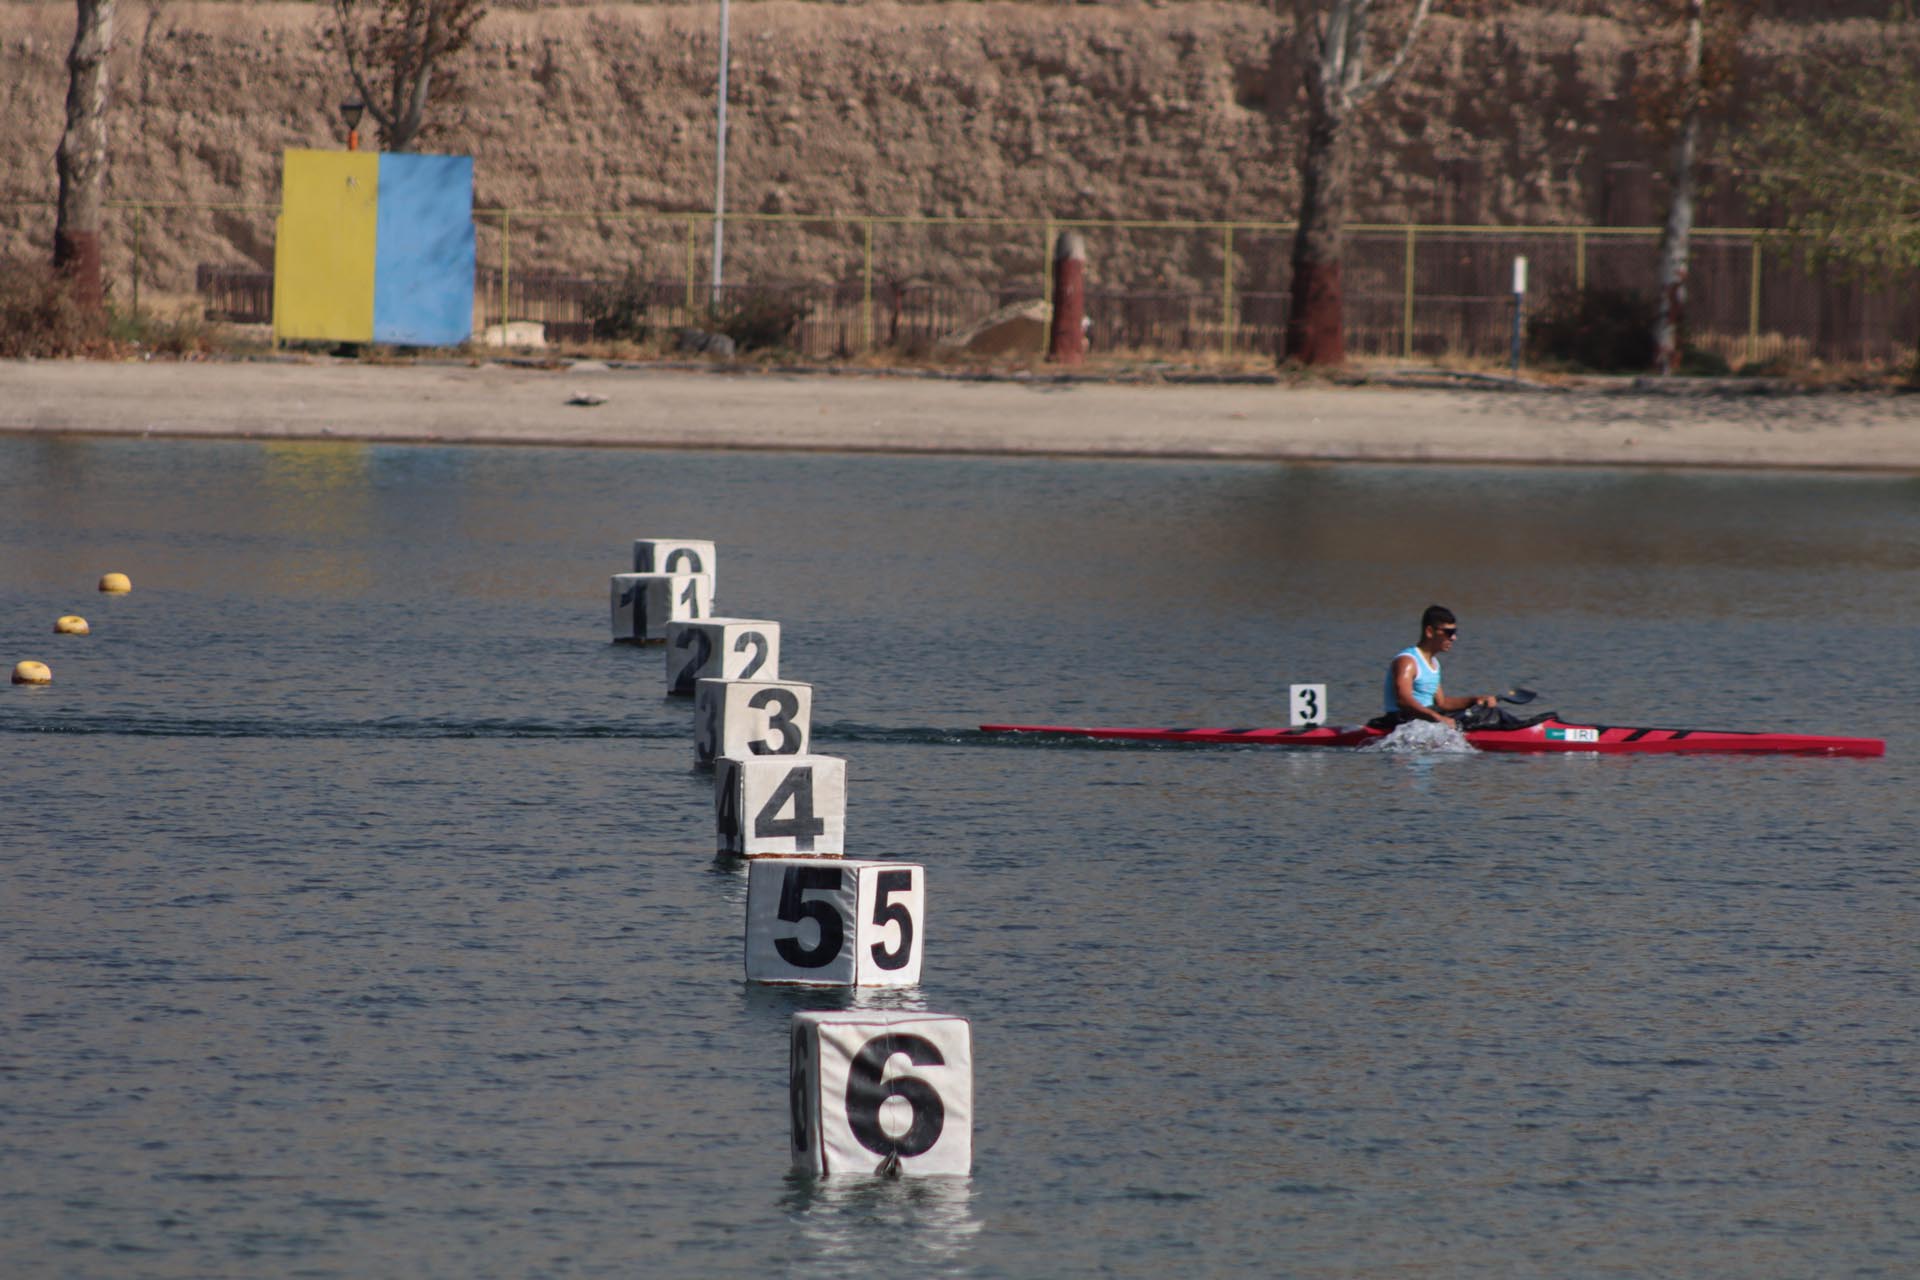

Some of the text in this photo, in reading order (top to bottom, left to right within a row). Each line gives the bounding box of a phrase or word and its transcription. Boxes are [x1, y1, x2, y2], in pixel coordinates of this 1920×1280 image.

[620, 579, 648, 637] 1
[681, 578, 699, 618] 1
[675, 628, 712, 690] 2
[735, 631, 768, 678] 2
[748, 688, 802, 755] 3
[1299, 689, 1318, 719] 3
[718, 766, 738, 851] 4
[755, 766, 824, 851] 4
[774, 866, 844, 968] 5
[871, 869, 914, 971] 5
[845, 1033, 945, 1158] 6
